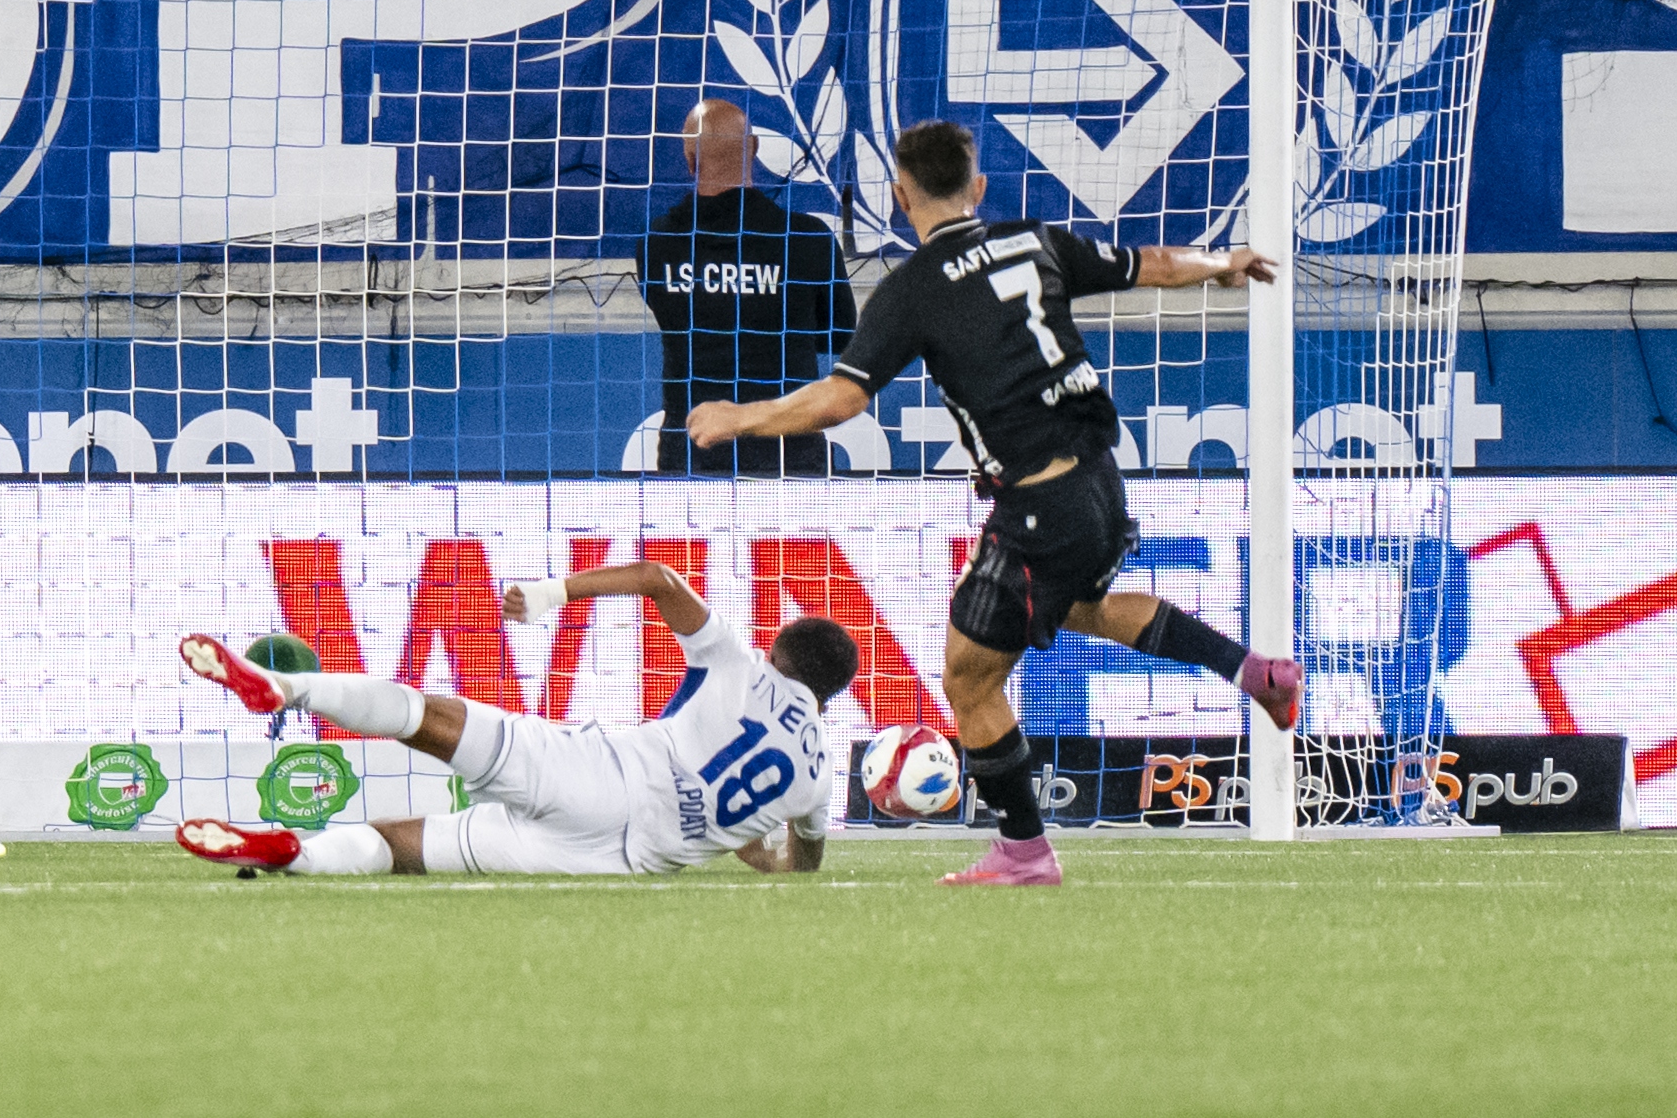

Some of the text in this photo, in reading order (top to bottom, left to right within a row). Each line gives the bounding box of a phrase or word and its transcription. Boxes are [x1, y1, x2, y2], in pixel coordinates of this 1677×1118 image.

[665, 263, 780, 296] LS CREW
[988, 260, 1066, 368] 7
[698, 715, 795, 827] 18
[752, 673, 825, 781] INEOS
